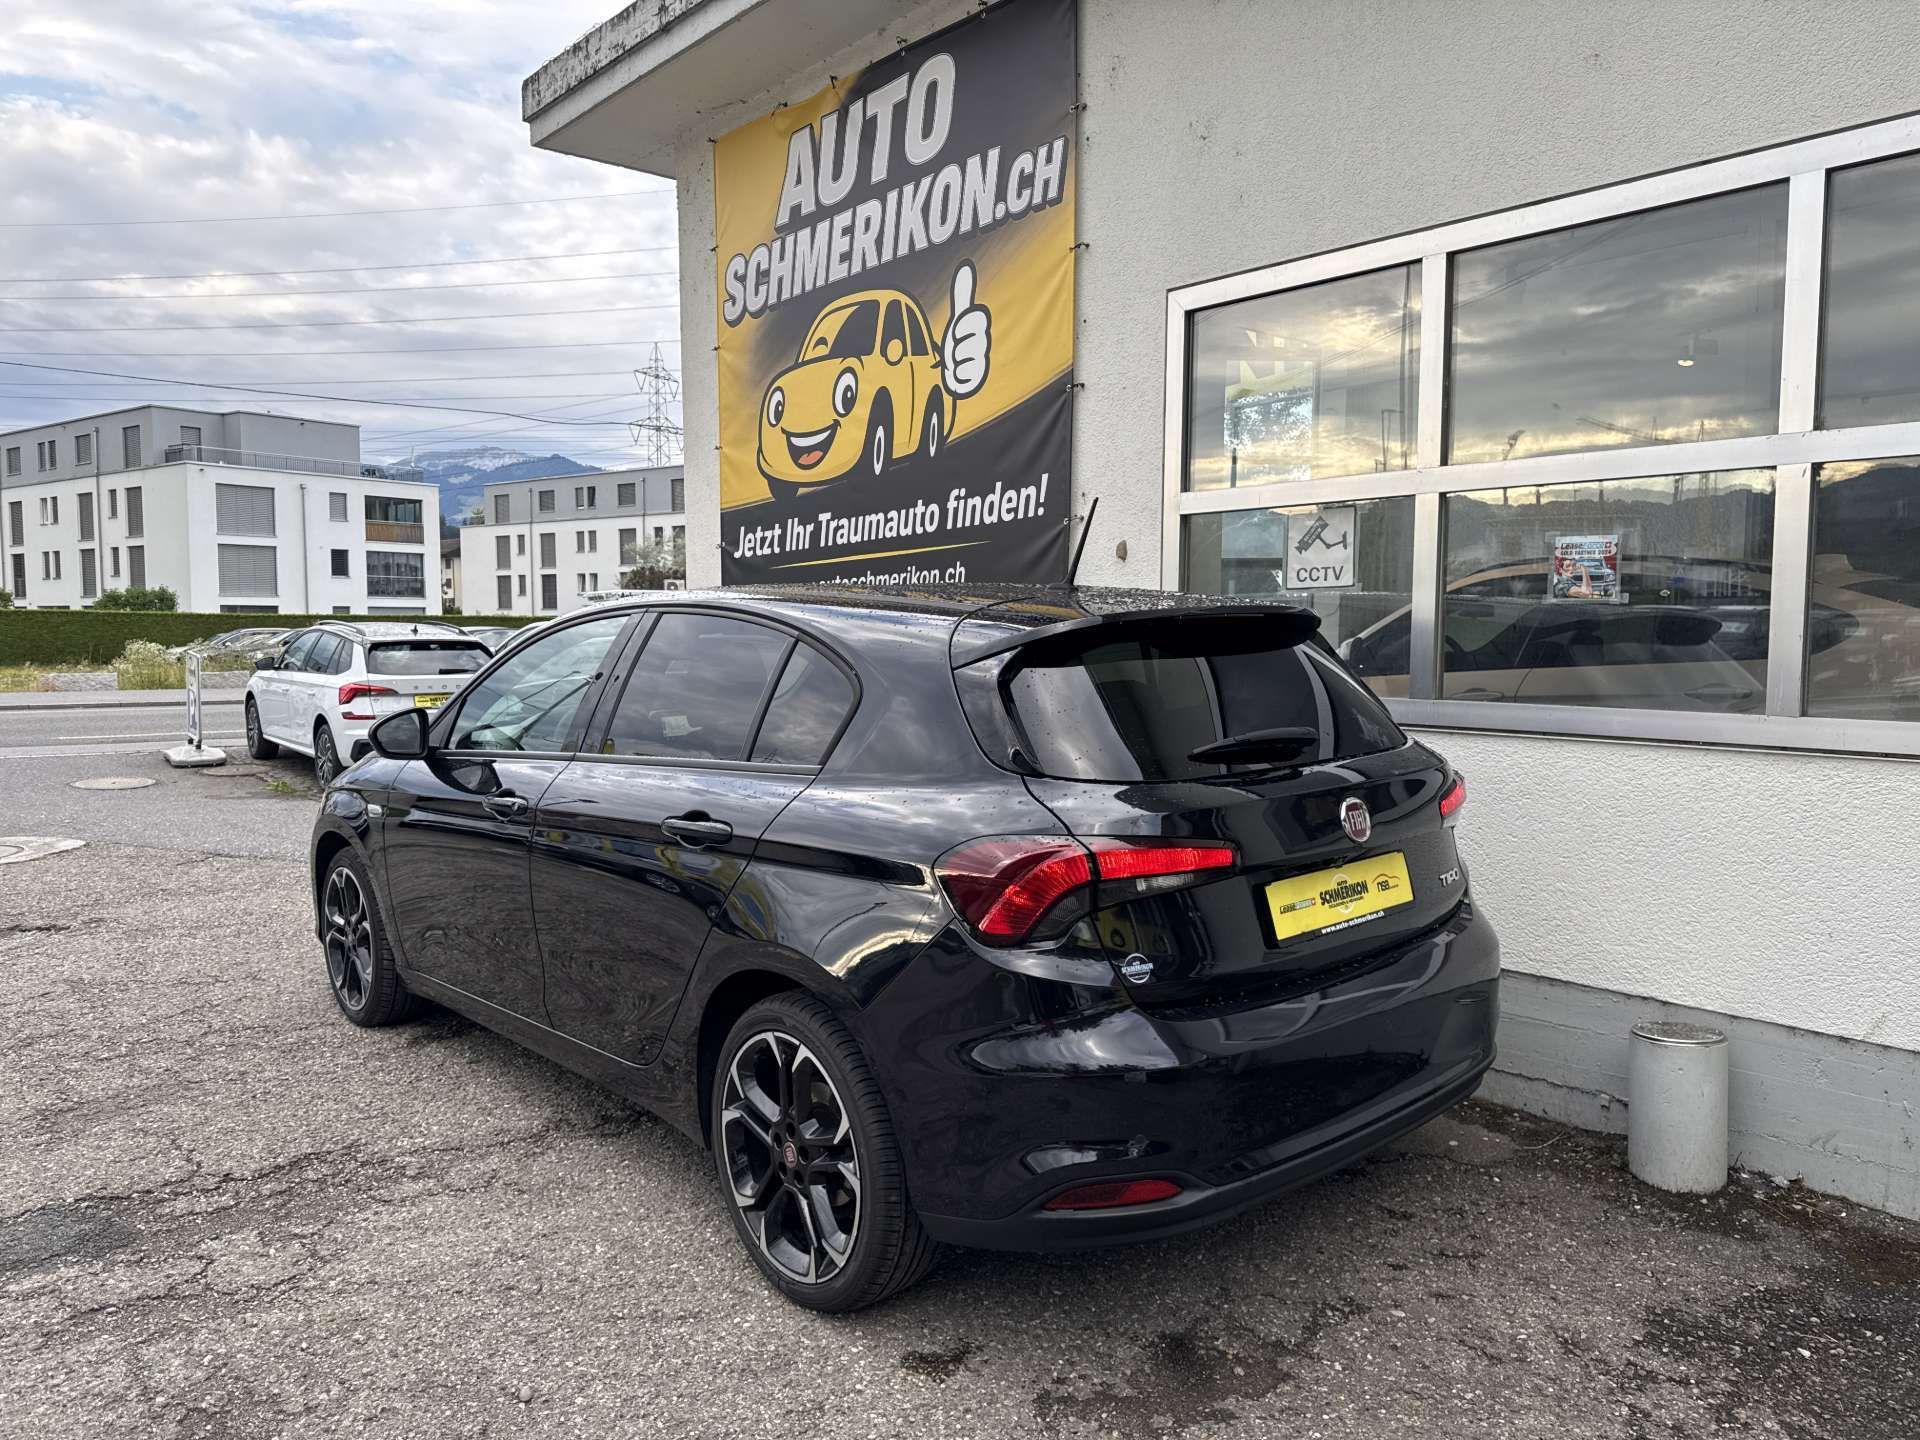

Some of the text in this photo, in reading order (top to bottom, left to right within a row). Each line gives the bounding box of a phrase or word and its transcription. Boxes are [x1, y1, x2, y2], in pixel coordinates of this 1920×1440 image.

[775, 51, 957, 229] AUTO
[722, 137, 1066, 323] SCHMERIKON.CH
[733, 472, 1049, 559] Jetzt Ihr Traumauto finden!
[1296, 565, 1344, 583] CCTV
[1319, 880, 1369, 906] SCHMERIKON
[1439, 867, 1460, 887] TIPO
